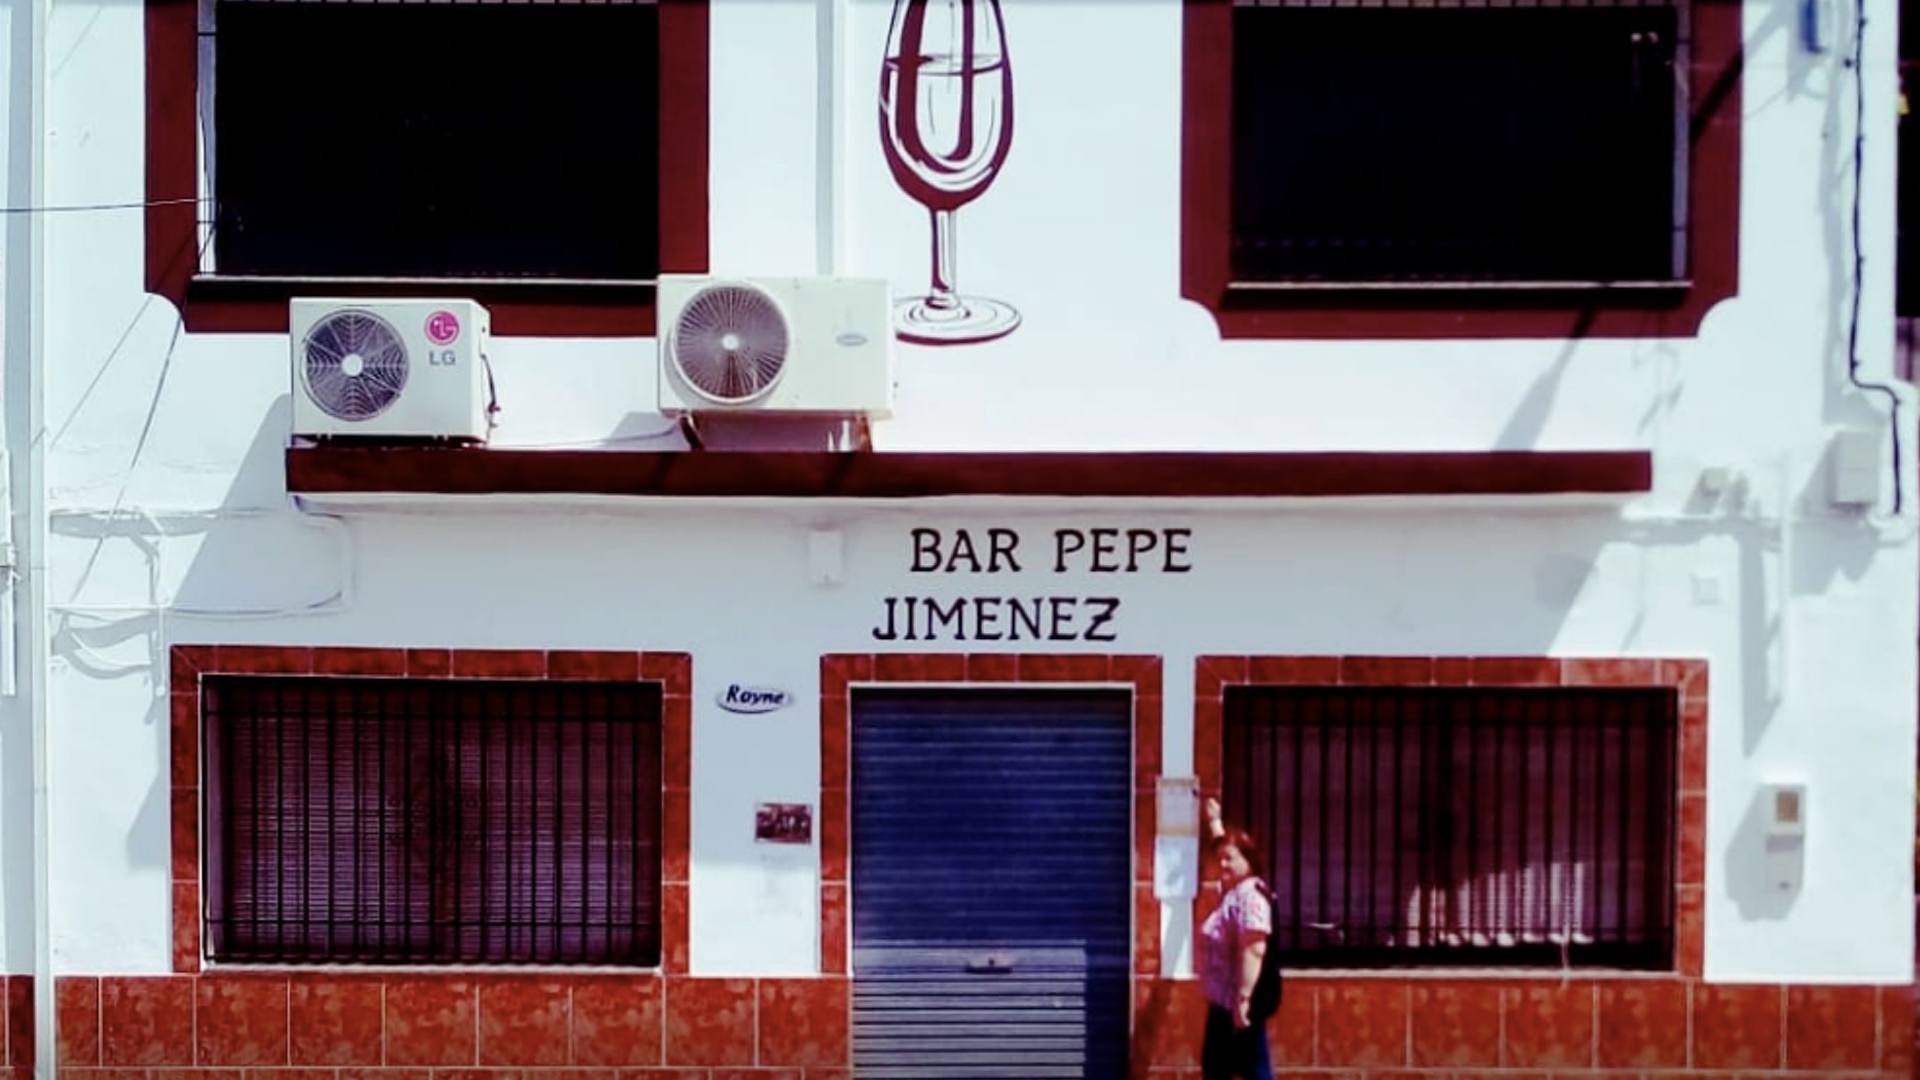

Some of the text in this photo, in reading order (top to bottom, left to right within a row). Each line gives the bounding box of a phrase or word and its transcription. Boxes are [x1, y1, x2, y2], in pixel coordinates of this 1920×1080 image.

[429, 350, 456, 366] LG
[910, 527, 1193, 573] BAR PEPE
[872, 596, 1121, 642] JIMENEZ
[726, 684, 784, 705] Royne
